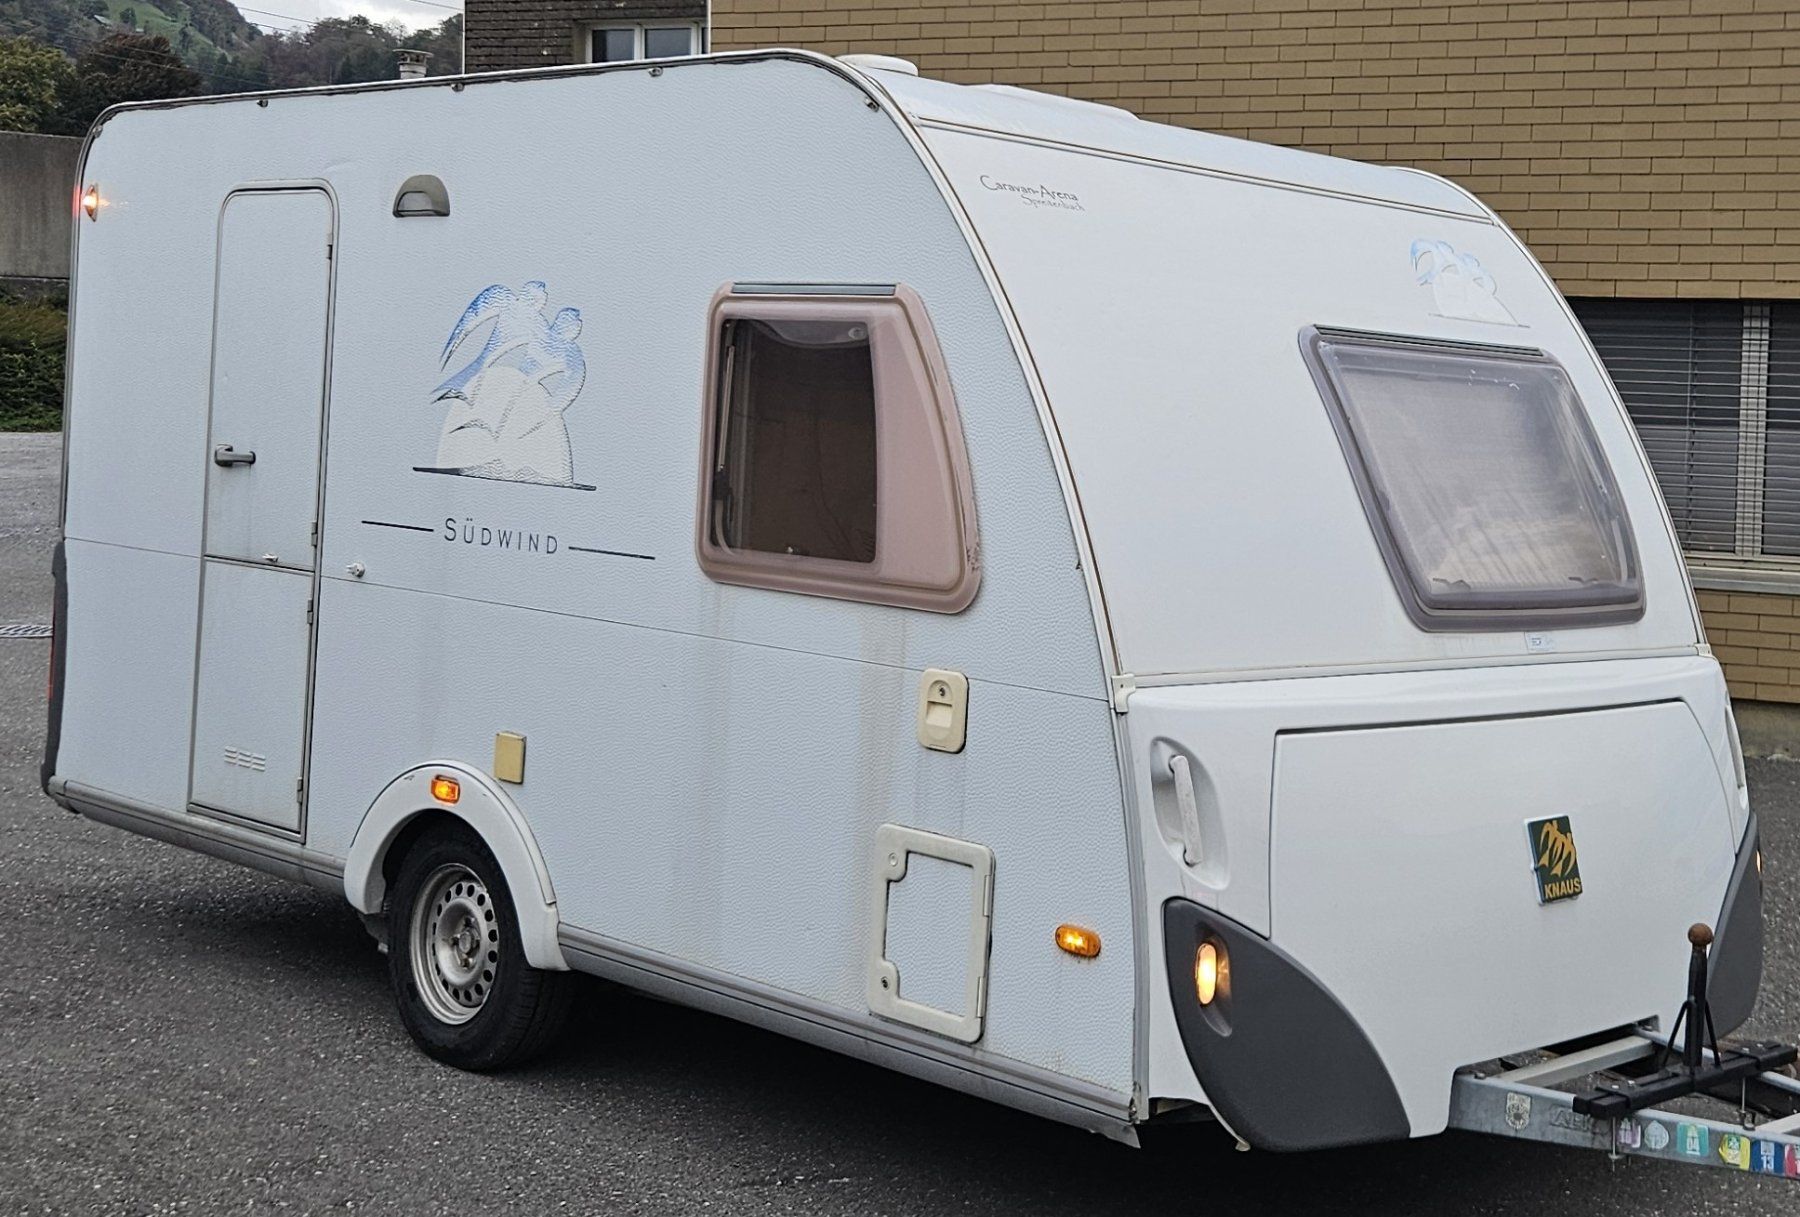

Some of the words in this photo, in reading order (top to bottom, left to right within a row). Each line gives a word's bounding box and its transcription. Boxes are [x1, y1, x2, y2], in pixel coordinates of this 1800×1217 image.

[980, 174, 1079, 201] Caravan-Arena
[444, 517, 558, 554] SÜDWIND
[1544, 878, 1581, 899] KNAUS
